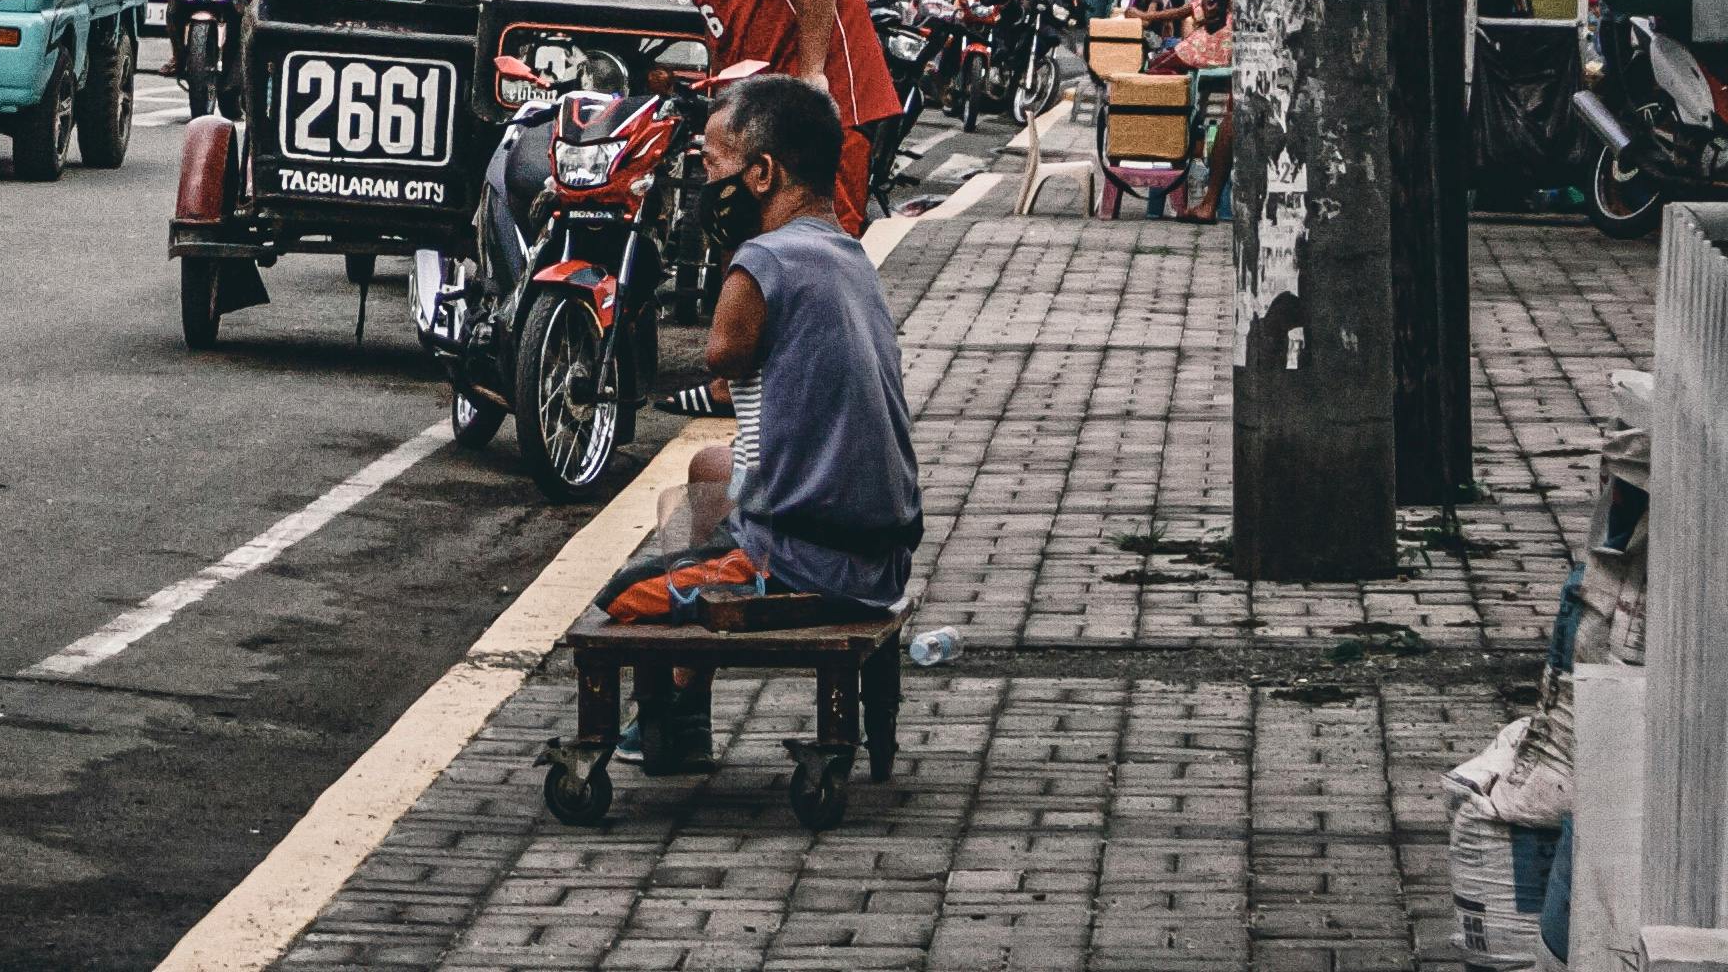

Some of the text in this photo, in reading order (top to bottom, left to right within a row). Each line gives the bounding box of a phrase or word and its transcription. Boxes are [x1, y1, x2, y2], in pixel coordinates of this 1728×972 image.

[294, 60, 440, 157] 2661
[278, 169, 444, 203] TAGBILARAN CITY
